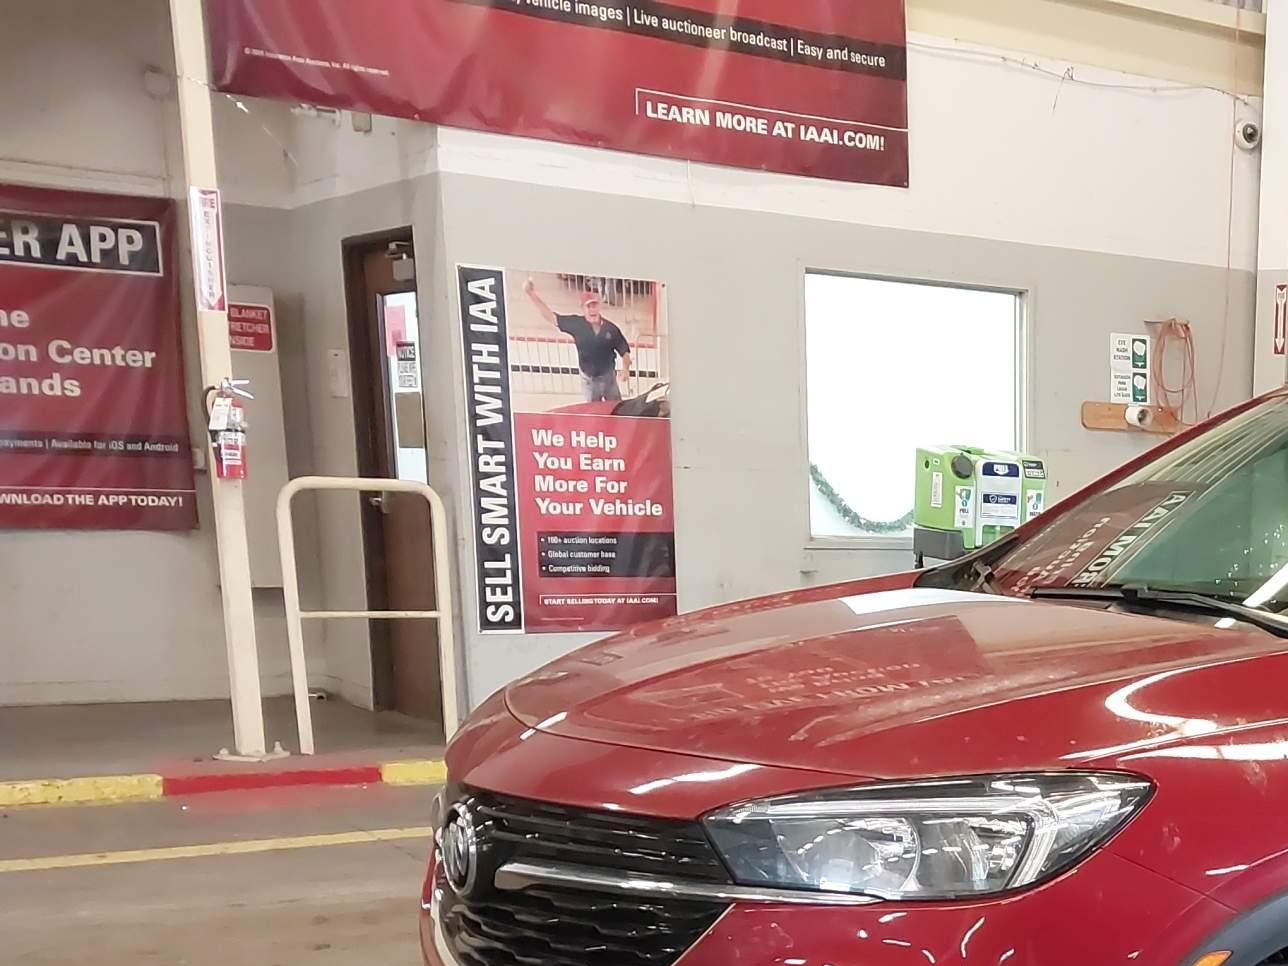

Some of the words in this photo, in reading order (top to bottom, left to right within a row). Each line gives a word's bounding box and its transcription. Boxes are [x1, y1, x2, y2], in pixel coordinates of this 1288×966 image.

[575, 3, 623, 20] images
[633, 9, 659, 27] Live
[661, 17, 727, 41] auctioneer
[729, 26, 788, 52] broadcast
[797, 39, 824, 61] Easy
[826, 46, 849, 62] and
[850, 50, 886, 68] secure
[646, 101, 711, 126] LEARN
[715, 112, 769, 135] MORE
[772, 122, 796, 138] AT
[799, 124, 886, 152] IAAI.COM!
[55, 223, 144, 266] APP
[468, 277, 498, 332] IAA
[47, 339, 157, 369] Center
[472, 343, 503, 426] WITH
[108, 439, 125, 450] iOS
[126, 441, 143, 451] and
[143, 441, 179, 453] Android
[532, 429, 565, 446] We
[571, 431, 617, 451] Help
[533, 452, 573, 470] You
[579, 454, 625, 471] Earn
[477, 435, 509, 545] SMART
[534, 475, 589, 493] More
[595, 477, 628, 493] For
[67, 494, 95, 506] THE
[97, 495, 128, 506] APP
[129, 495, 183, 507] TODAY!
[535, 498, 584, 515] Your
[589, 499, 663, 516] Vehicle
[588, 536, 617, 545] locations
[547, 550, 569, 558] Global
[486, 553, 513, 622] SELL
